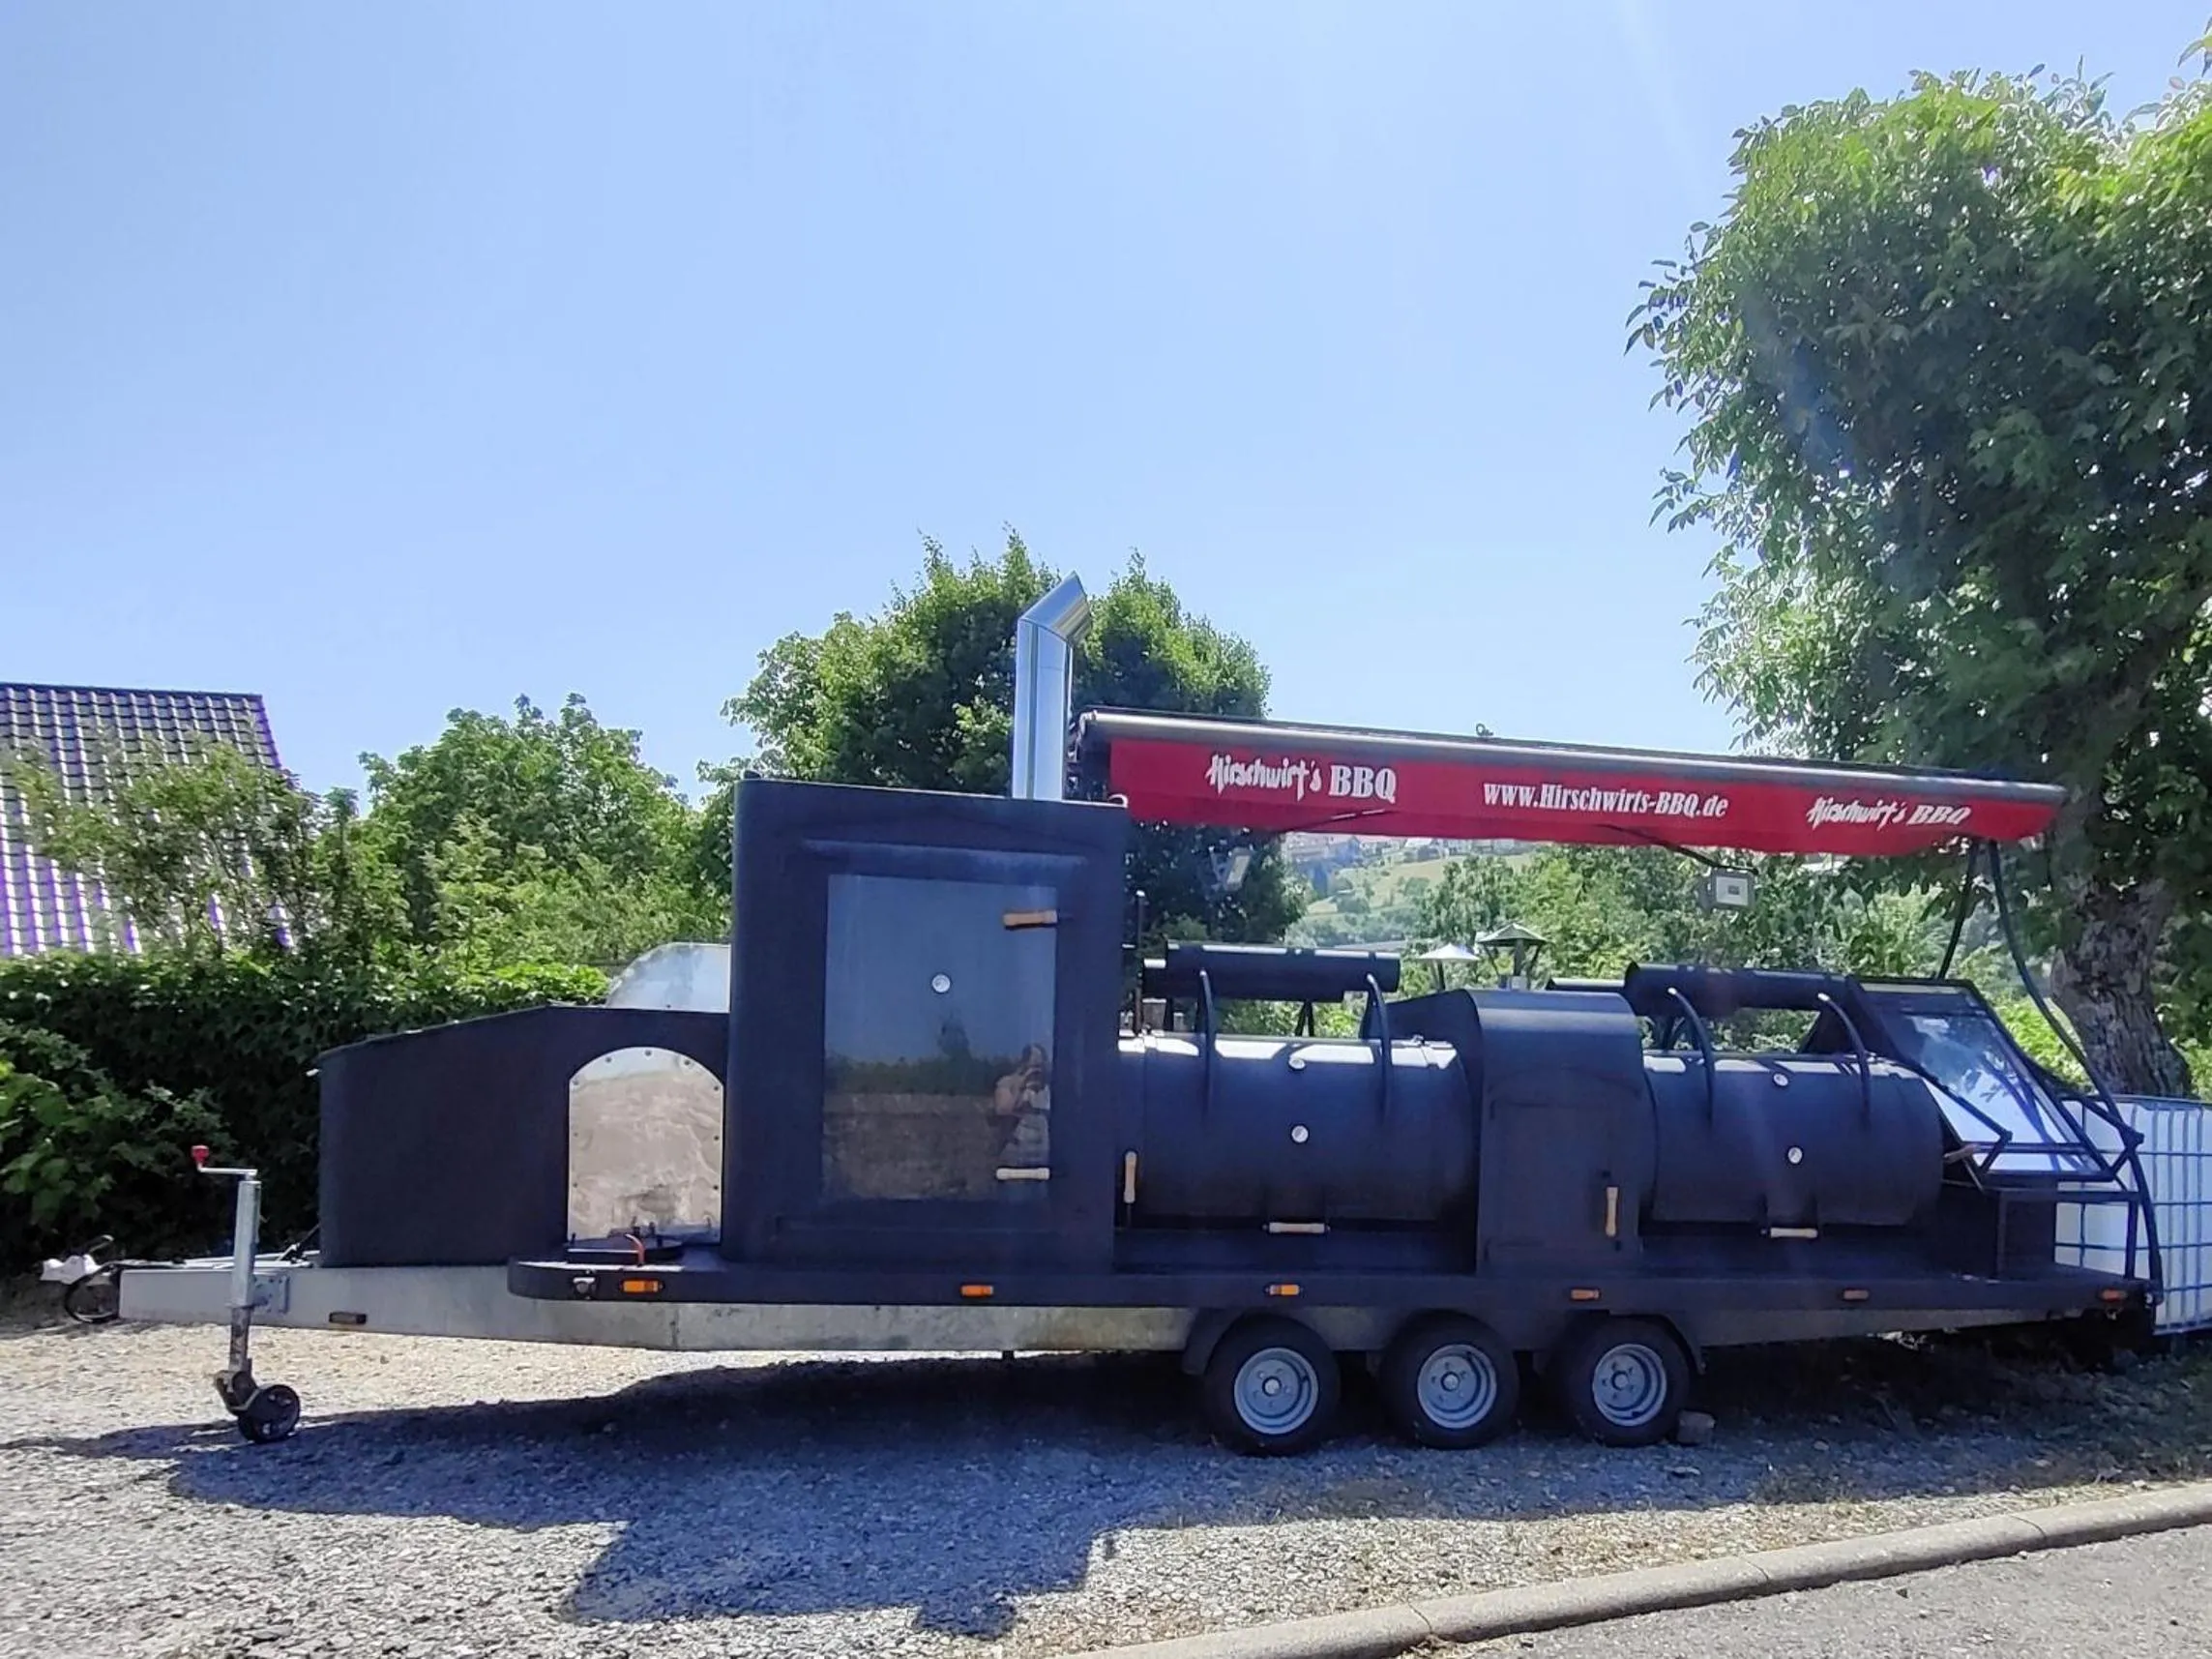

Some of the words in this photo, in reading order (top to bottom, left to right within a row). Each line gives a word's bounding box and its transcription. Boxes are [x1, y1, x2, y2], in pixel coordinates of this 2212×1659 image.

[1205, 754, 1322, 801] Hirschwirt's
[1328, 764, 1397, 804] BBQ
[1906, 805, 1971, 825] BBQ
